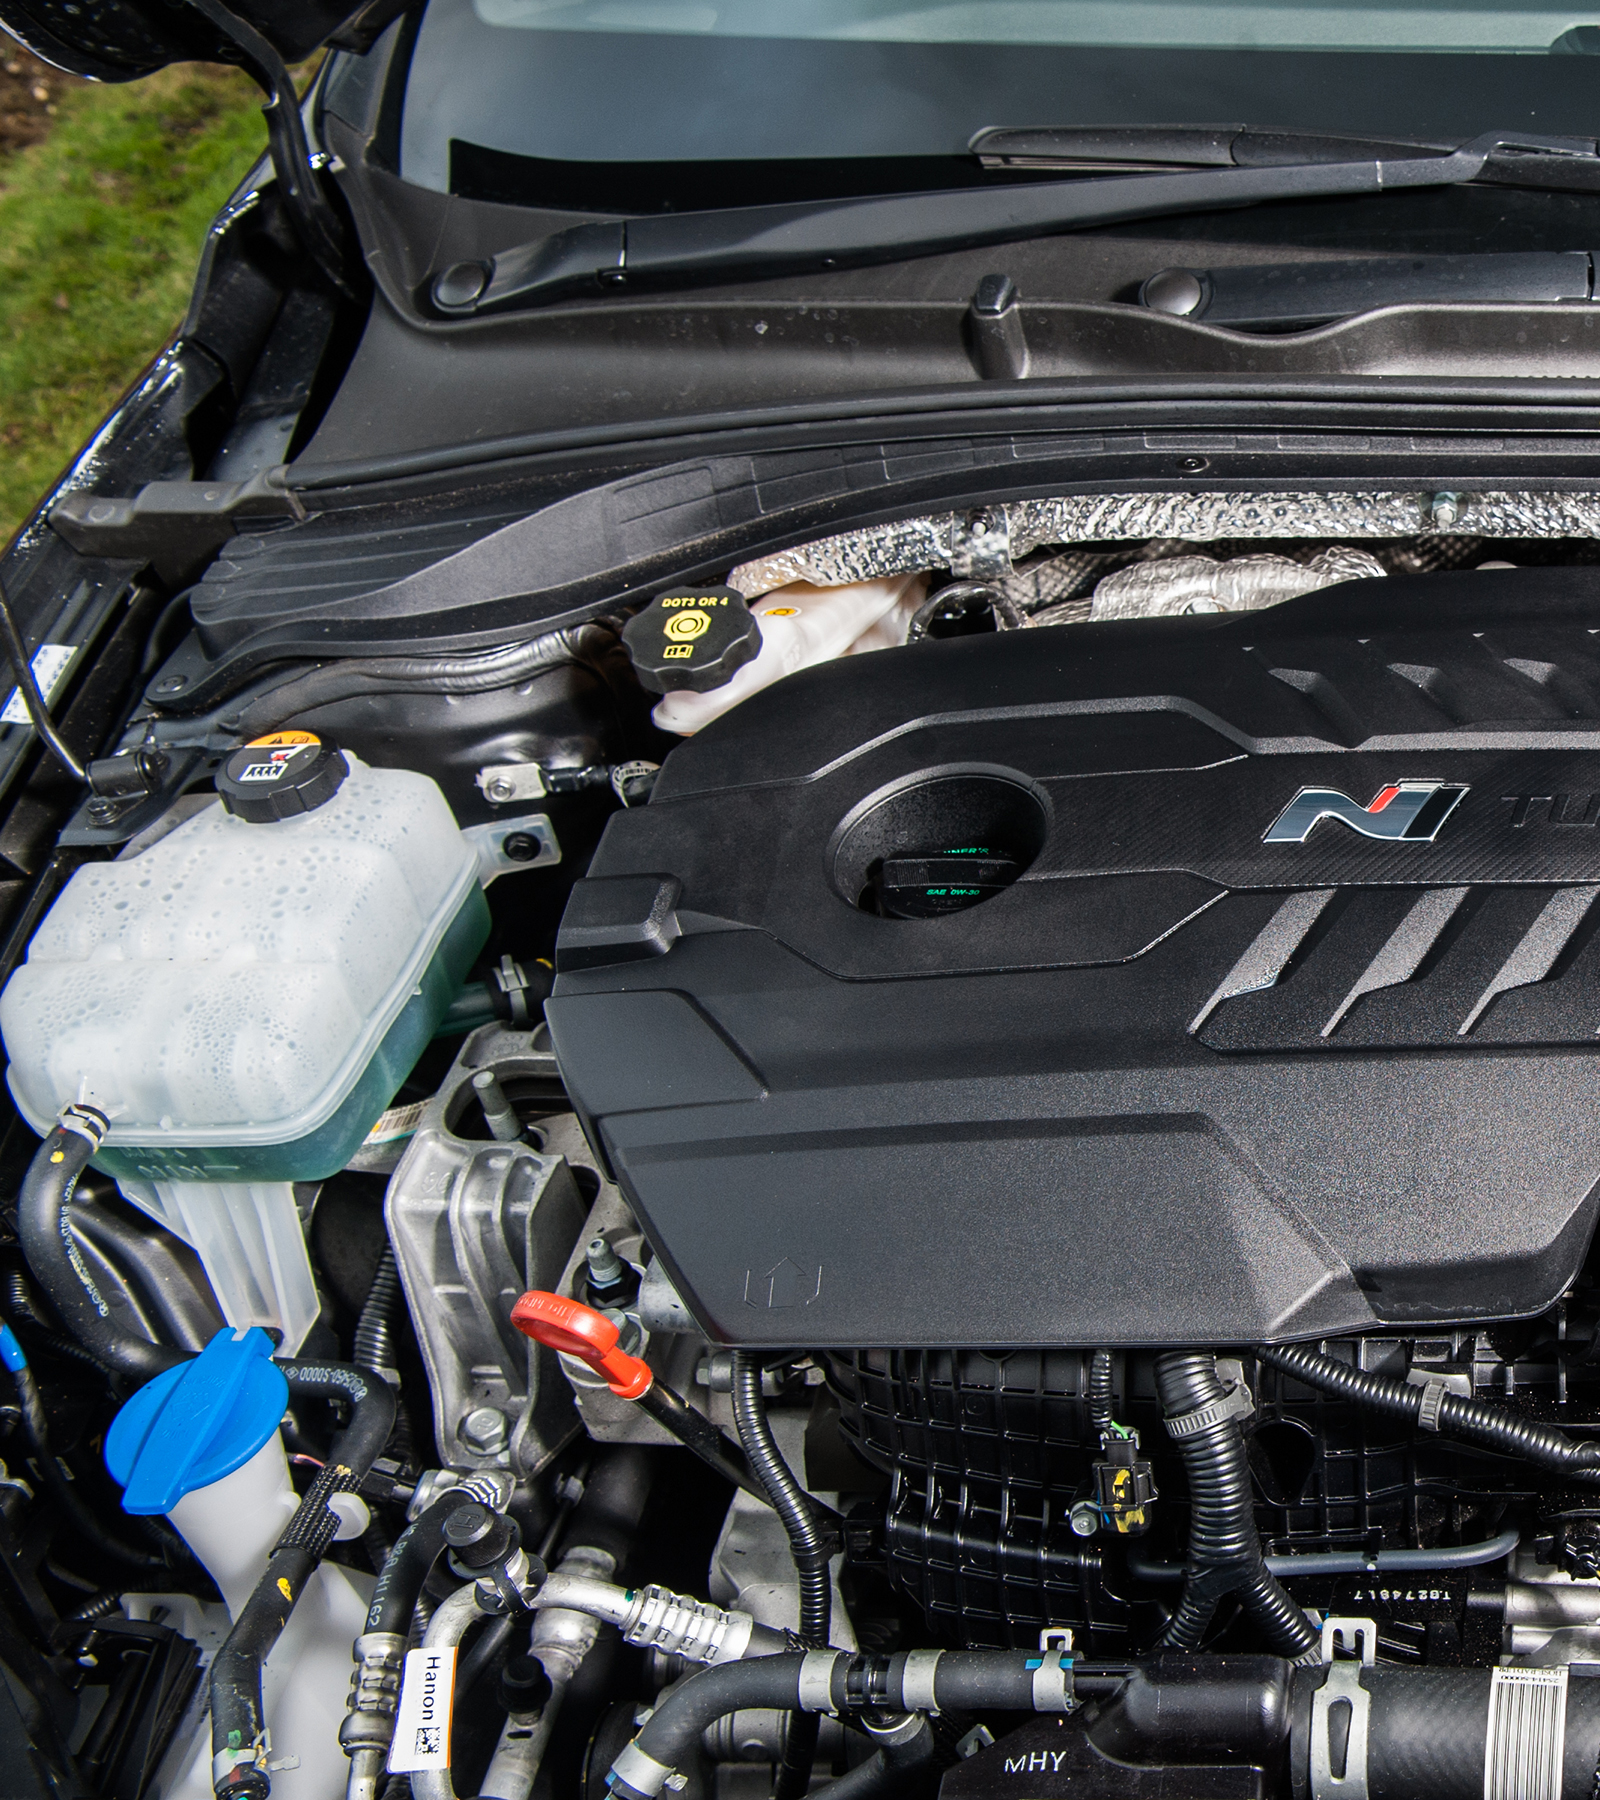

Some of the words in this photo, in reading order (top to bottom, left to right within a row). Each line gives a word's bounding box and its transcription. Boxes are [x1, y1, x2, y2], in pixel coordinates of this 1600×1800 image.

[661, 597, 696, 608] DOT3
[698, 596, 718, 607] OR
[719, 596, 729, 606] 4
[926, 888, 947, 896] SAE
[950, 888, 980, 896] 0W-30
[421, 1656, 442, 1721] Hanon
[1004, 1750, 1067, 1773] MHY
